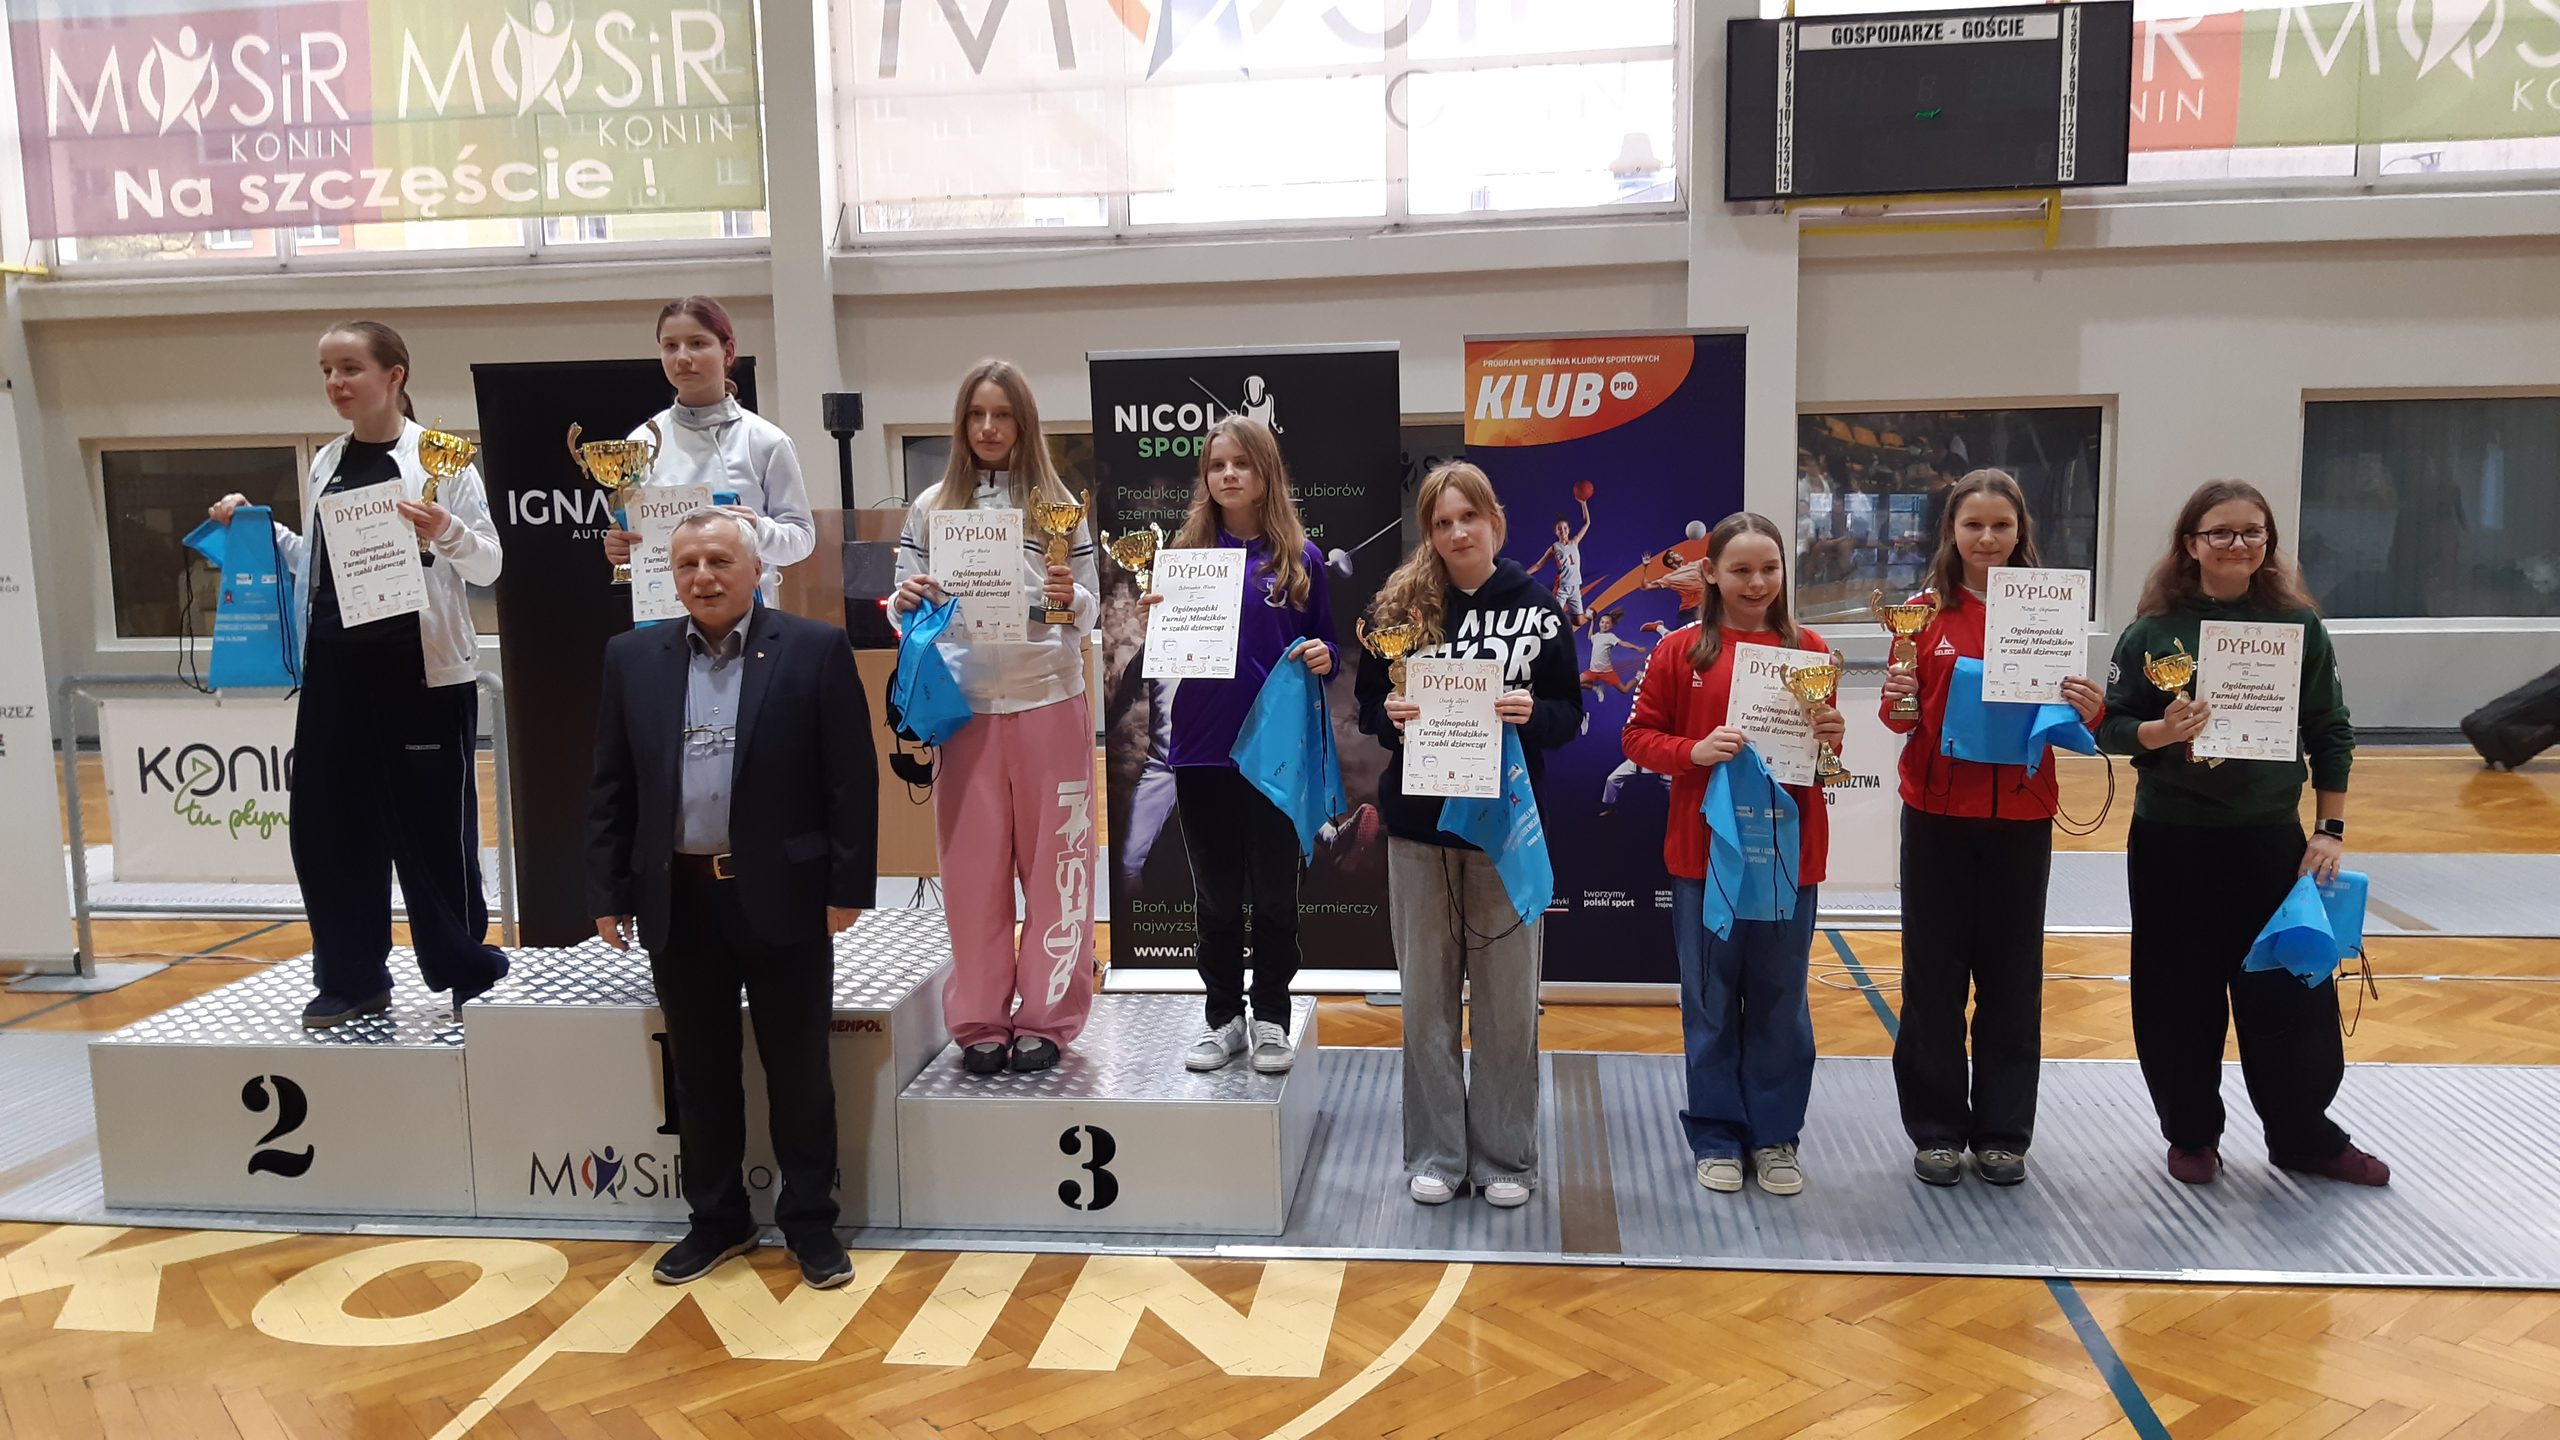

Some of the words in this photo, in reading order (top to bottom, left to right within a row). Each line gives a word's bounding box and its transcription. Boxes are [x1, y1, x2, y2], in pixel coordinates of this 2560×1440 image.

[2072, 11, 2078, 23] 4
[1786, 25, 1792, 36] 4
[1831, 22, 1944, 45] GOSPODARZE
[1962, 16, 2025, 39] GOŚCIE
[2071, 25, 2077, 37] 5
[1786, 40, 1792, 52] 5
[2070, 39, 2076, 51] 6
[1786, 53, 1792, 66] 6
[2070, 53, 2076, 66] 7
[1785, 68, 1792, 78] 7
[2070, 67, 2076, 80] 8
[1785, 81, 1791, 94] 8
[2069, 82, 2076, 94] 9
[1785, 96, 1791, 107] 9
[2062, 95, 2075, 108] 10
[2130, 88, 2205, 123] NIN
[1778, 108, 1791, 122] 10
[2062, 110, 2074, 122] 11
[598, 110, 733, 149] KONIN
[1778, 123, 1790, 136] 11
[2062, 123, 2074, 136] 12
[231, 128, 352, 163] KONIN
[1778, 137, 1790, 150] 12
[2061, 137, 2074, 150] 13
[1778, 150, 1790, 163] 13
[2060, 152, 2073, 164] 14
[1778, 164, 1790, 177] 14
[2060, 165, 2072, 178] 15
[114, 167, 215, 220] Na
[240, 145, 614, 217] szczęście
[1778, 178, 1789, 191] 15
[1483, 359, 1520, 367] PROGRAM
[1522, 357, 1570, 366] WSPIERANIA
[1571, 355, 1604, 365] KLUBÓW
[1606, 354, 1660, 364] SPORTOWYCH
[1474, 372, 1604, 420] KLUB
[1613, 381, 1634, 392] PRO
[1114, 403, 1217, 432] NICOL
[1117, 486, 1189, 502] Produkcja
[1304, 482, 1366, 497] ubiorów
[335, 499, 394, 524] DYPLOM
[508, 488, 617, 526] IGNA
[1118, 507, 1190, 520] szermierc
[572, 529, 608, 541] AUTO
[945, 526, 1007, 541] DYPLOM
[952, 569, 1001, 579] Ogólnopolski
[1168, 564, 1228, 579] DYPLOM
[2005, 584, 2073, 601] DYPLOM
[1172, 604, 1218, 614] Ogólnopolski
[1161, 615, 1188, 624] Turniej
[2010, 626, 2064, 636] Ogólnopolski
[2000, 637, 2029, 646] Turniej
[2217, 638, 2286, 656] DYPLOM
[1423, 675, 1487, 692] DYPLOM
[2222, 681, 2275, 691] Ogólnopolski
[2210, 691, 2240, 701] Turniej
[1429, 718, 1479, 728] Ogólnopolski
[1419, 729, 1447, 738] Turniej
[229, 799, 290, 840] płyn
[1584, 890, 1626, 900] tworzymy
[1132, 900, 1170, 914] Broń,
[1298, 901, 1378, 917] zermierczy
[1584, 898, 1610, 907] polski
[1611, 898, 1635, 908] sport
[241, 1073, 315, 1178] 2
[1058, 1123, 1120, 1213] 3
